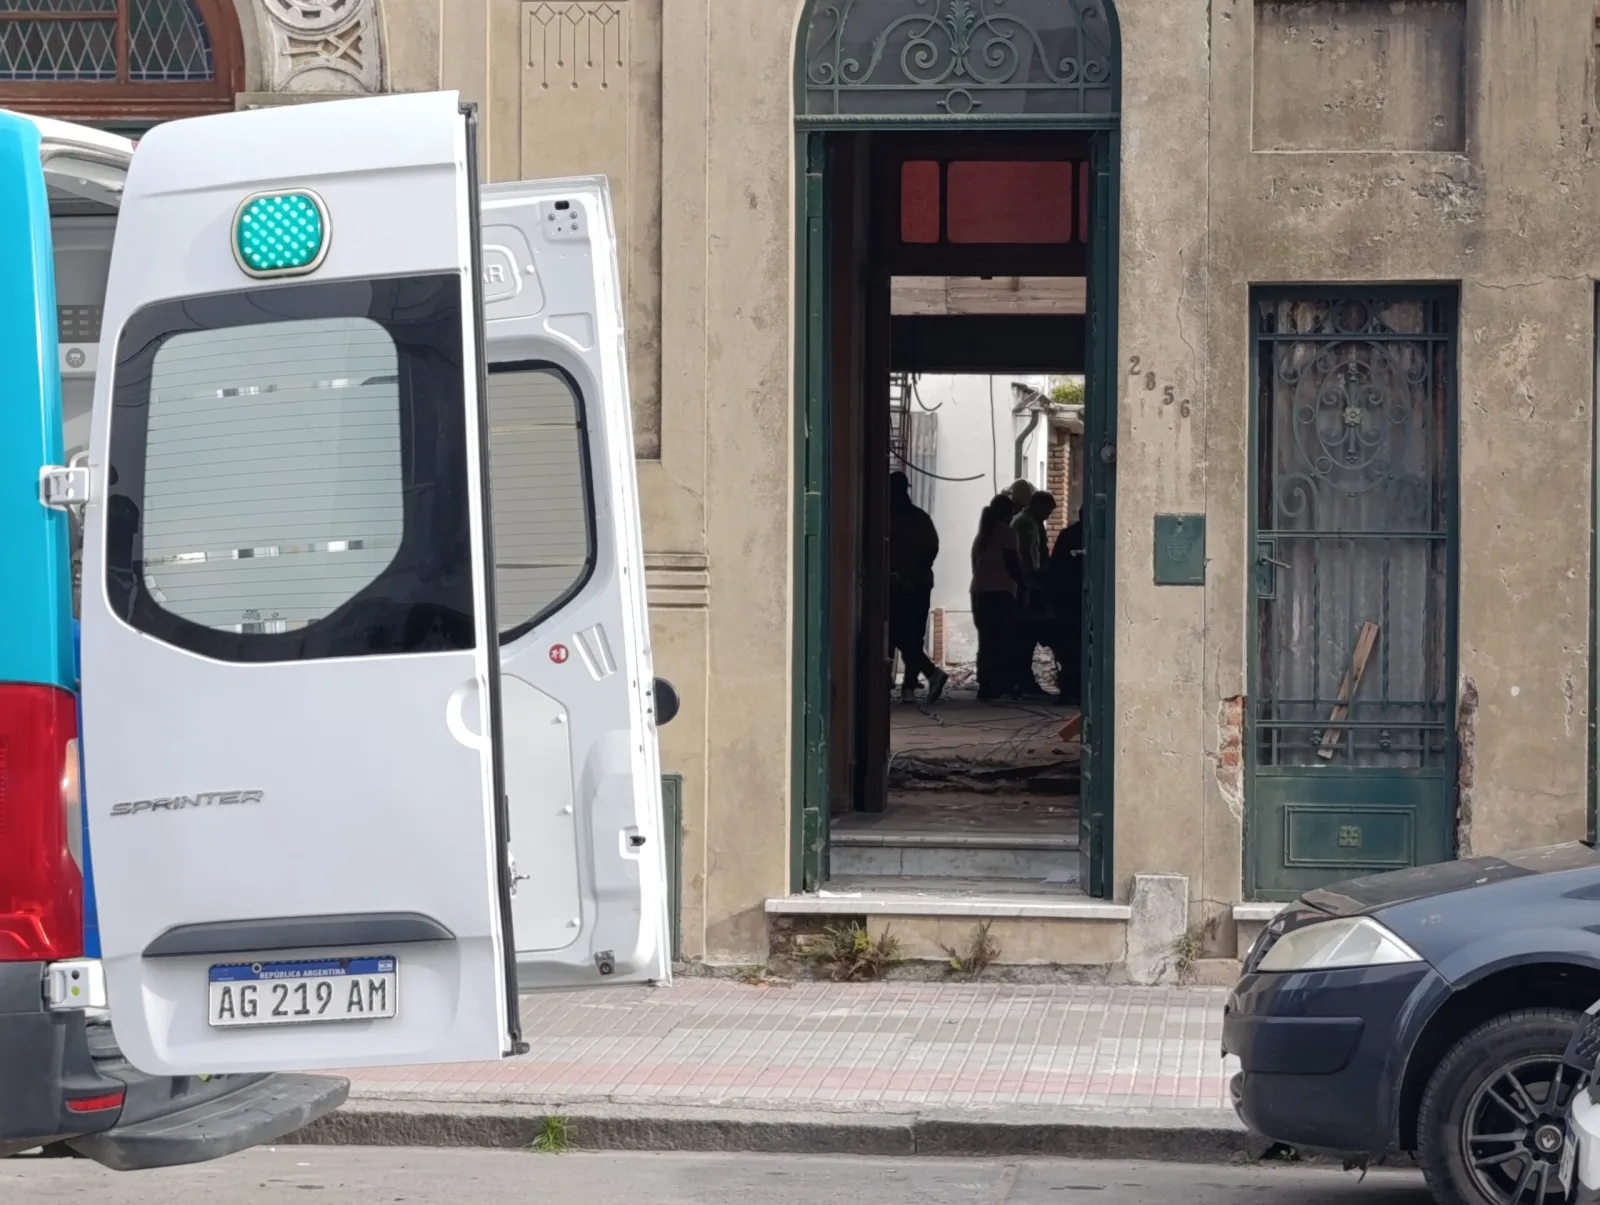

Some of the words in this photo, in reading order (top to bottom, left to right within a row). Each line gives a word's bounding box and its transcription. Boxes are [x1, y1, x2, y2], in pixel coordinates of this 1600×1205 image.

[1128, 355, 1191, 418] 2856
[109, 789, 264, 816] SPRINTER
[259, 970, 301, 979] REPÚBLICA
[303, 968, 346, 977] ARGENTINA
[218, 985, 258, 1019] AG
[271, 981, 333, 1016] 219
[347, 977, 386, 1013] AM
